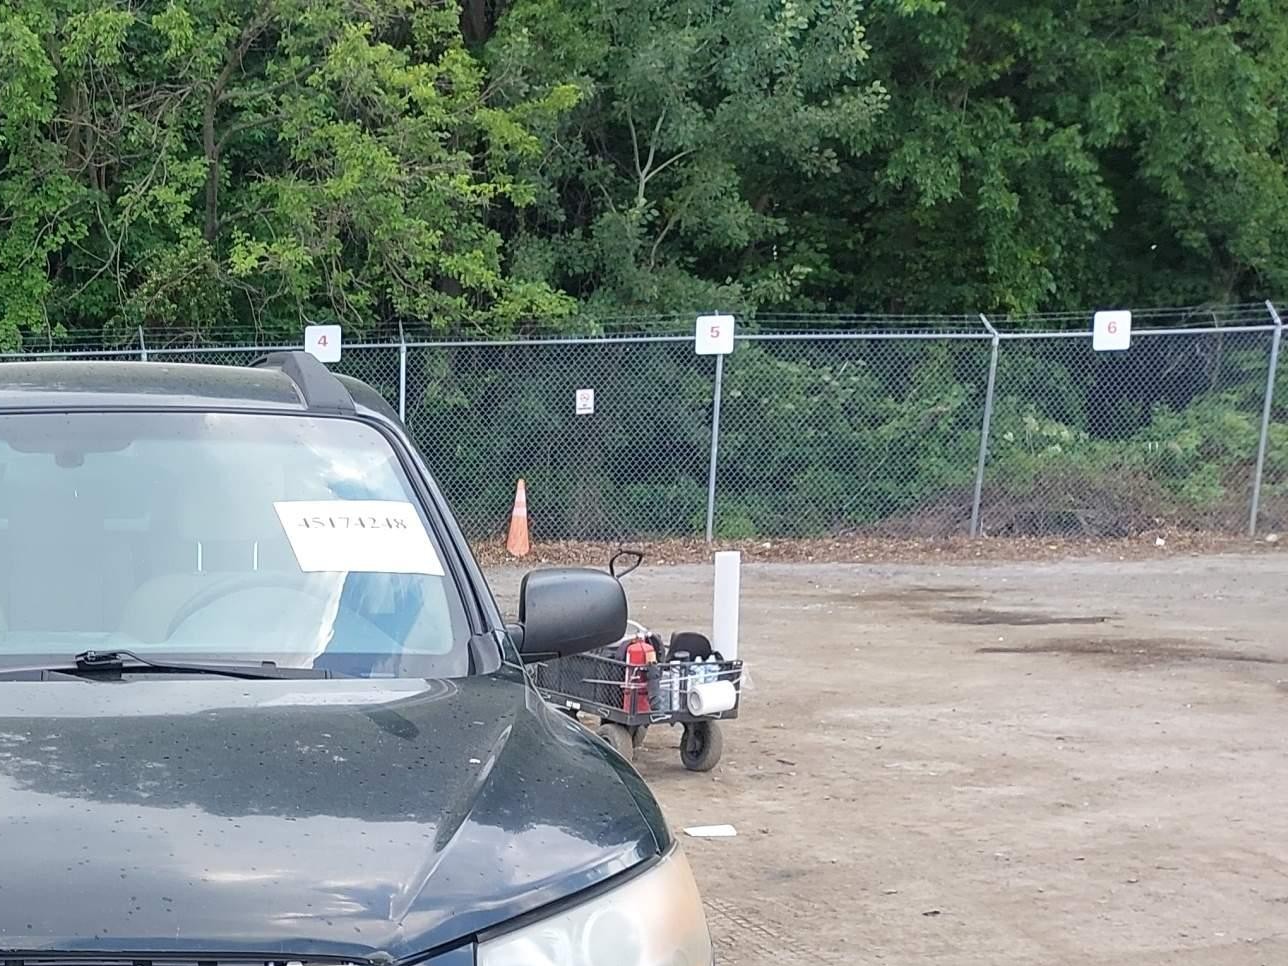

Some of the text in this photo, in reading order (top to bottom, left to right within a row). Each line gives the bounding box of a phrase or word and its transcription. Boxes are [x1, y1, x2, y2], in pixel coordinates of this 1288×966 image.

[710, 326, 720, 338] 5
[1107, 320, 1117, 334] 6
[317, 335, 328, 347] 4
